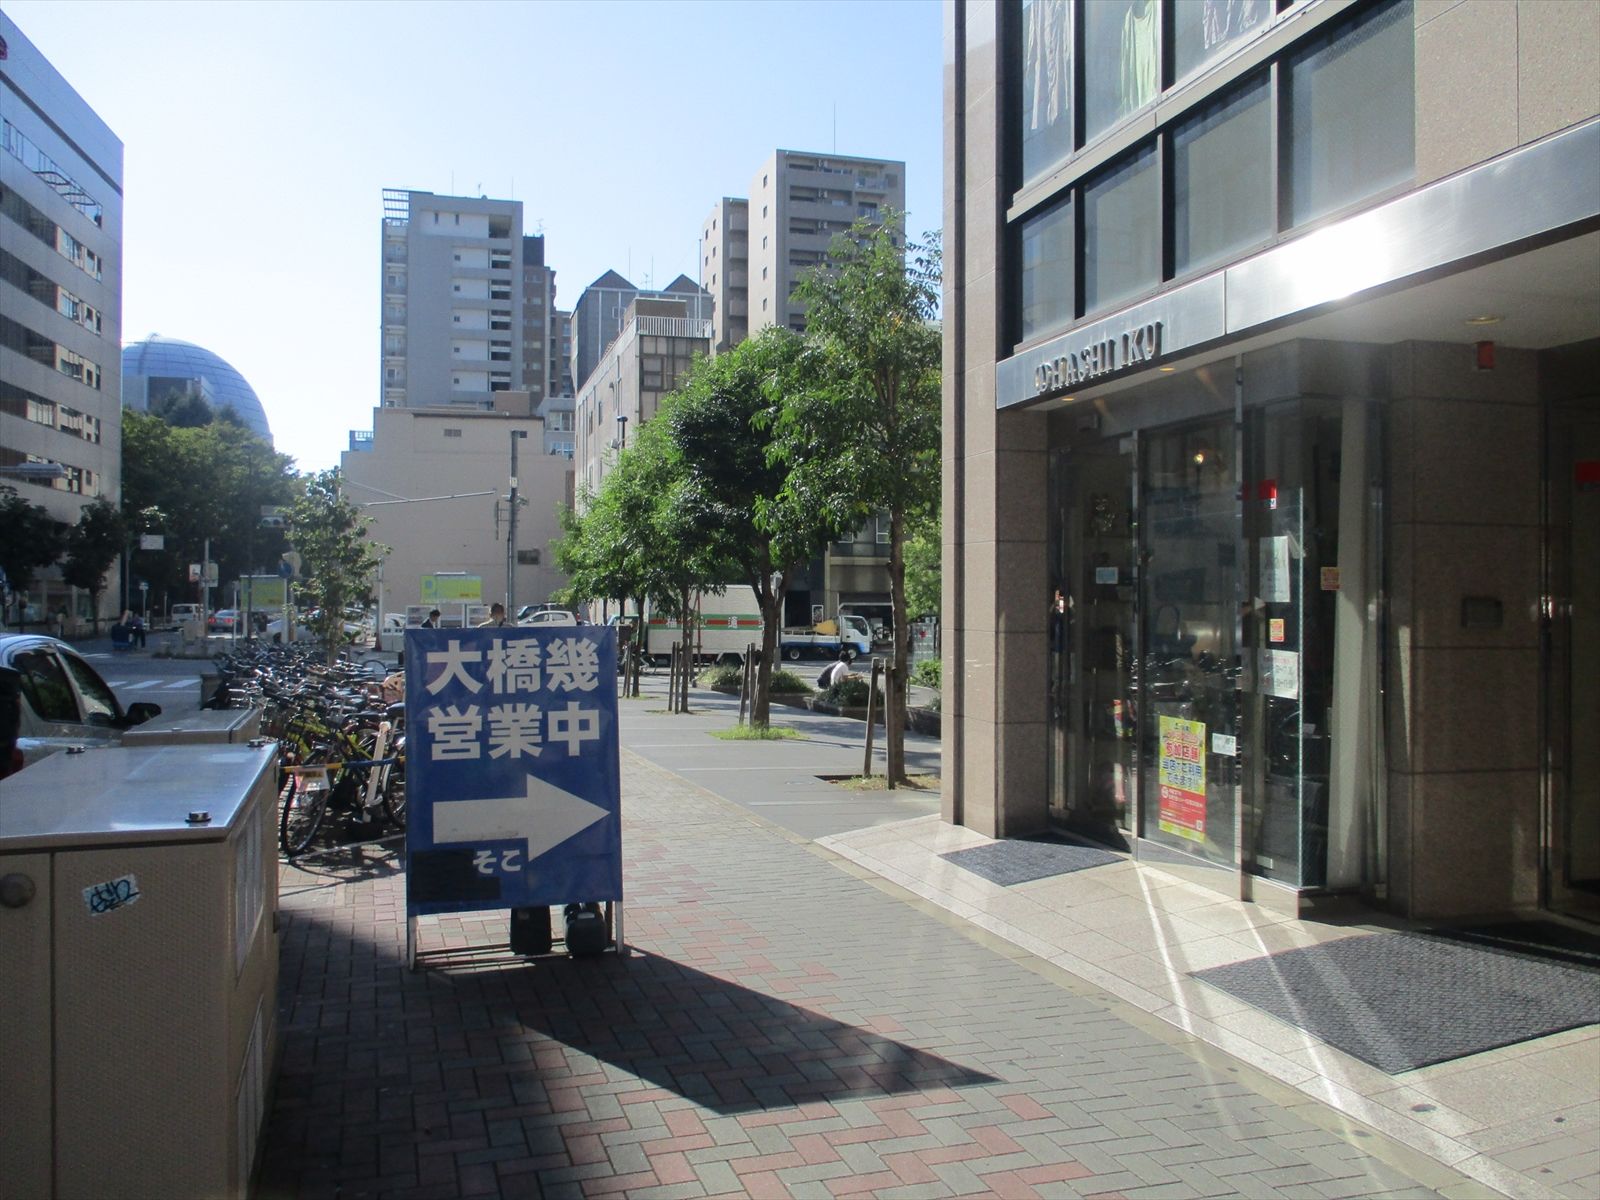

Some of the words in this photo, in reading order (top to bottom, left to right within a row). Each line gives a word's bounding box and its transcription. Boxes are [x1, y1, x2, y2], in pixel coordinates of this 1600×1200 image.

[1035, 339, 1117, 392] OHASHI
[1120, 320, 1164, 367] IKU
[426, 637, 600, 696] 大橋幾
[427, 701, 601, 761] 営業中
[472, 849, 522, 875] そこ
